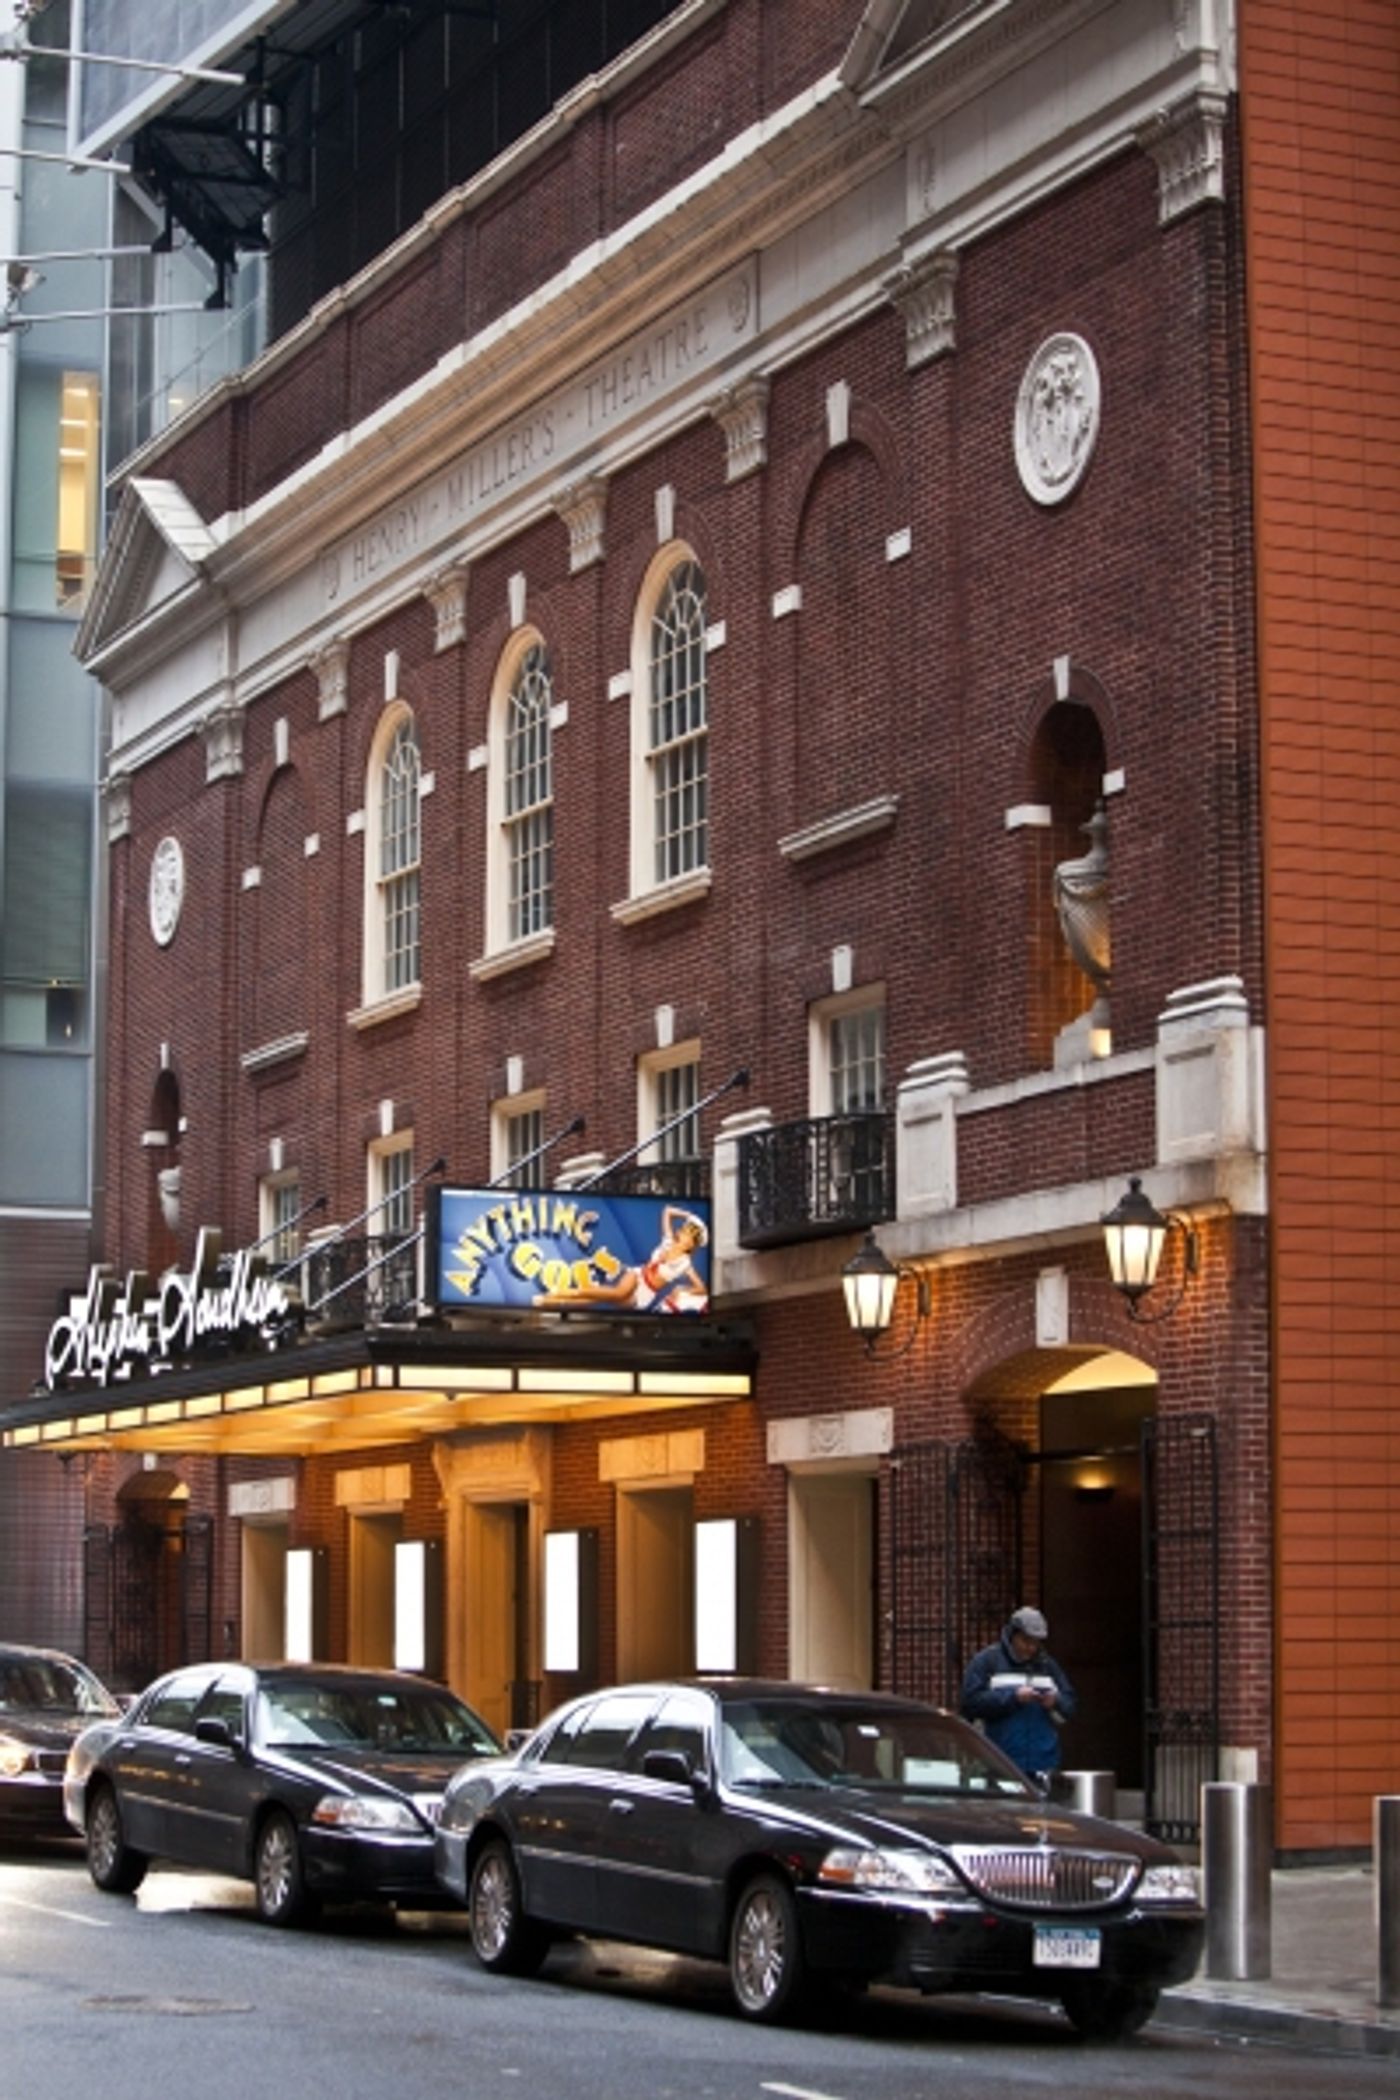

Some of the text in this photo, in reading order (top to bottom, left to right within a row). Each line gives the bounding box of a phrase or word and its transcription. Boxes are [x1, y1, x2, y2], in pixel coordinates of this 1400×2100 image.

[353, 306, 709, 583] HENRY MILLER'S THEATRE
[443, 1197, 600, 1297] ANYTHING
[512, 1241, 621, 1294] GOES
